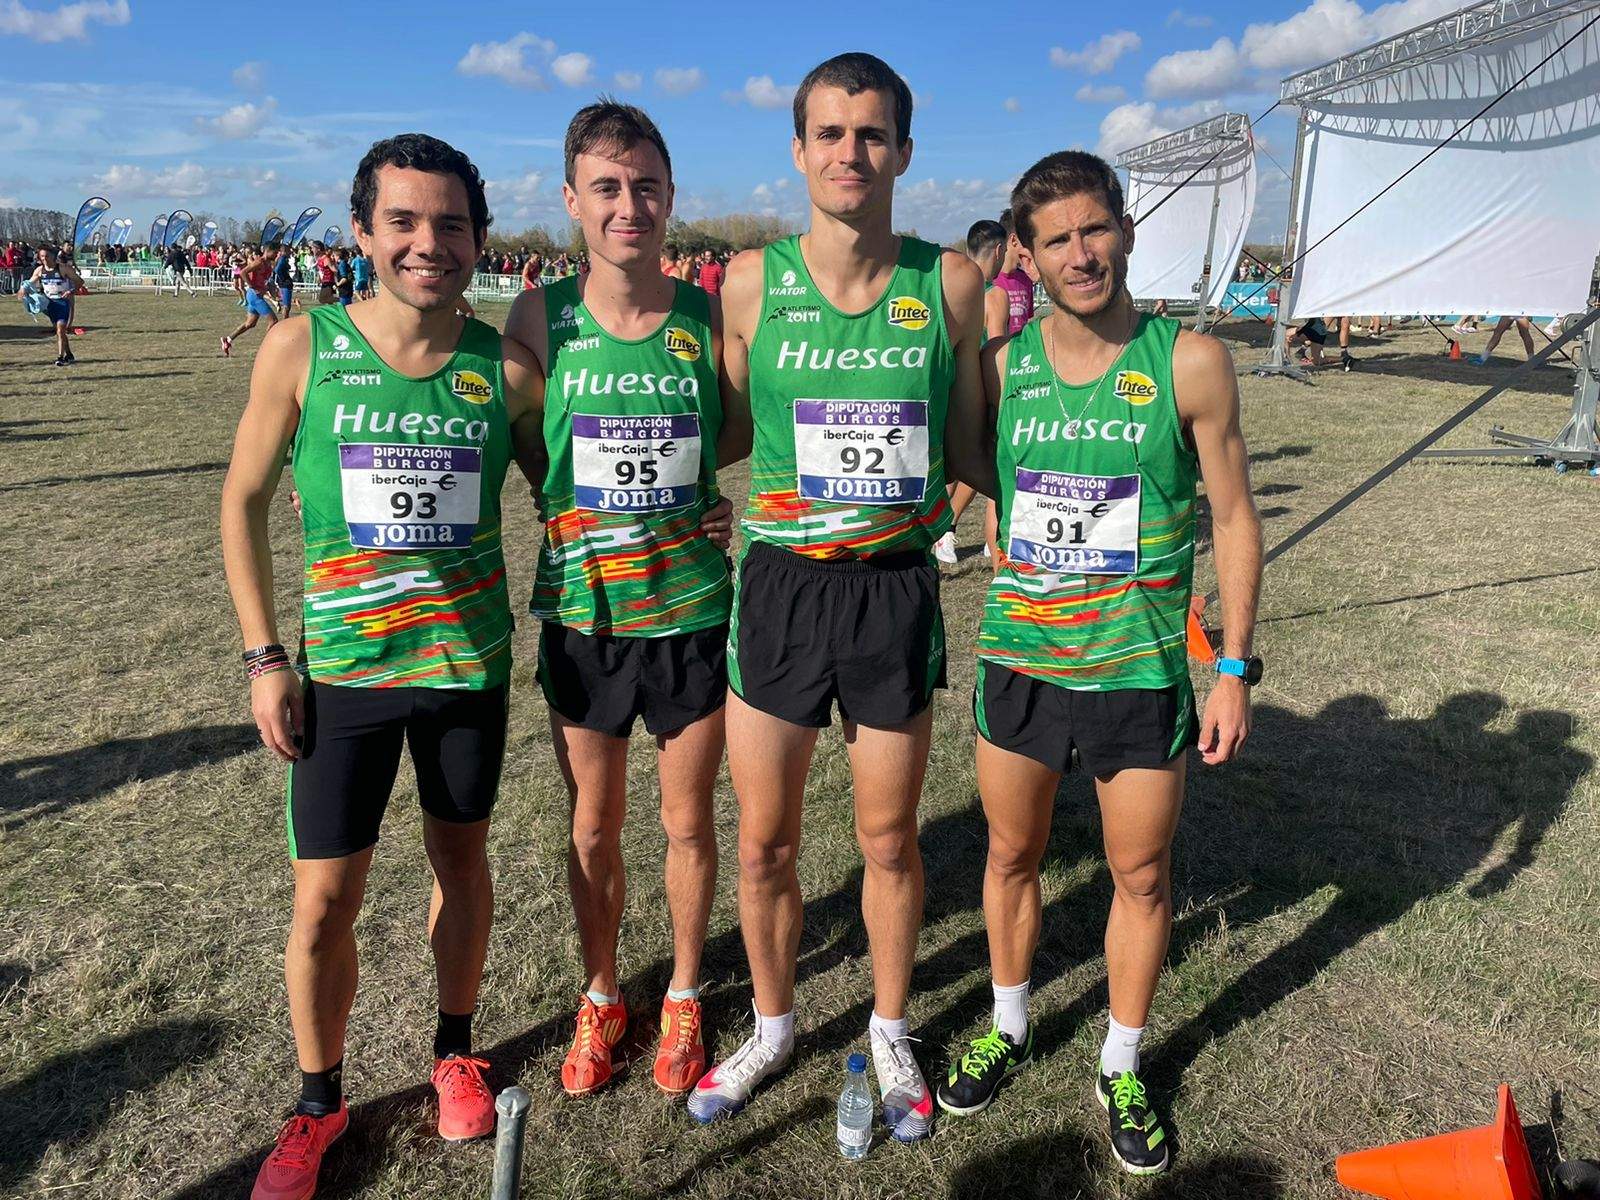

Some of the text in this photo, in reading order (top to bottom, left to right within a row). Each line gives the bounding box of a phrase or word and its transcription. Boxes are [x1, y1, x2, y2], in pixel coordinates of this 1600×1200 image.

[768, 286, 807, 296] VIATOR
[551, 316, 585, 330] VIATOR
[786, 311, 821, 323] ZOITI
[567, 337, 600, 353] ZOITI
[318, 350, 364, 360] VIATOR
[776, 340, 928, 370] Huesca
[342, 374, 382, 386] ZOITI
[562, 367, 699, 400] Huesca
[1021, 386, 1051, 401] ZOITI
[825, 401, 901, 414] DIPUTACIÓN
[332, 403, 489, 442] Huesca
[599, 417, 672, 428] DIPUTACIÓN
[825, 413, 901, 425] BURGOS
[600, 428, 672, 439] BURGOS
[823, 429, 875, 443] iberCaja
[1011, 416, 1147, 447] Huesca
[372, 446, 453, 459] DIPUTACIÓN
[597, 442, 649, 456] iberCaja
[373, 458, 453, 470] BURGOS
[839, 446, 886, 474] 92
[614, 459, 659, 486] 95
[371, 473, 428, 488] iberCaja
[1040, 473, 1107, 490] DIPUTACIÓN
[1040, 484, 1107, 500] BURGOS
[389, 491, 438, 519] 93
[1035, 497, 1080, 516] iberCaja
[1045, 517, 1087, 544] 91
